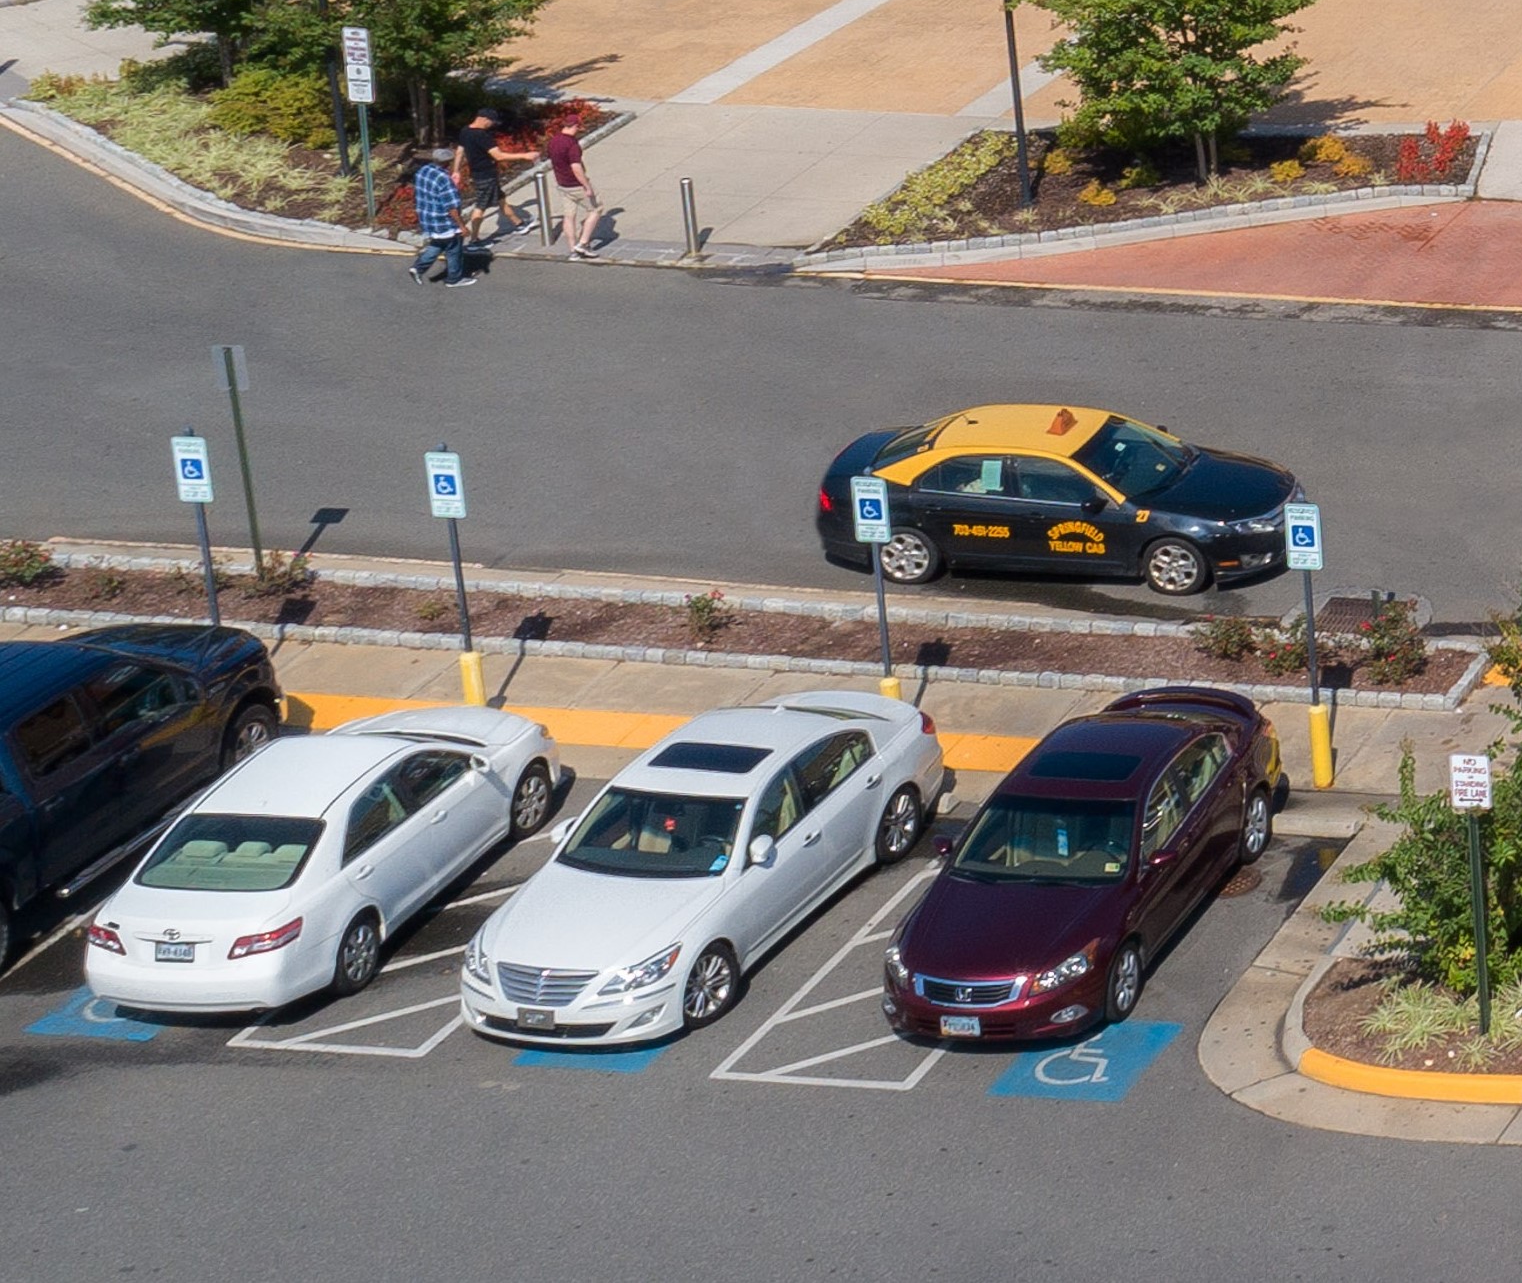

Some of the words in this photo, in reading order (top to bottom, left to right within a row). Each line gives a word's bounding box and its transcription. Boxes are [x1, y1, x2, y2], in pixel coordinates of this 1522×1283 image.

[1136, 510, 1151, 523] 27
[1047, 521, 1104, 543] SPRINGFIELD
[1049, 540, 1084, 553] YELLOW
[1085, 542, 1106, 555] CAB
[1463, 758, 1477, 766] NO
[1453, 766, 1487, 775] PARKING
[1455, 780, 1488, 789] STANDING
[1455, 788, 1468, 797] FIRE
[1470, 789, 1487, 799] LANE
